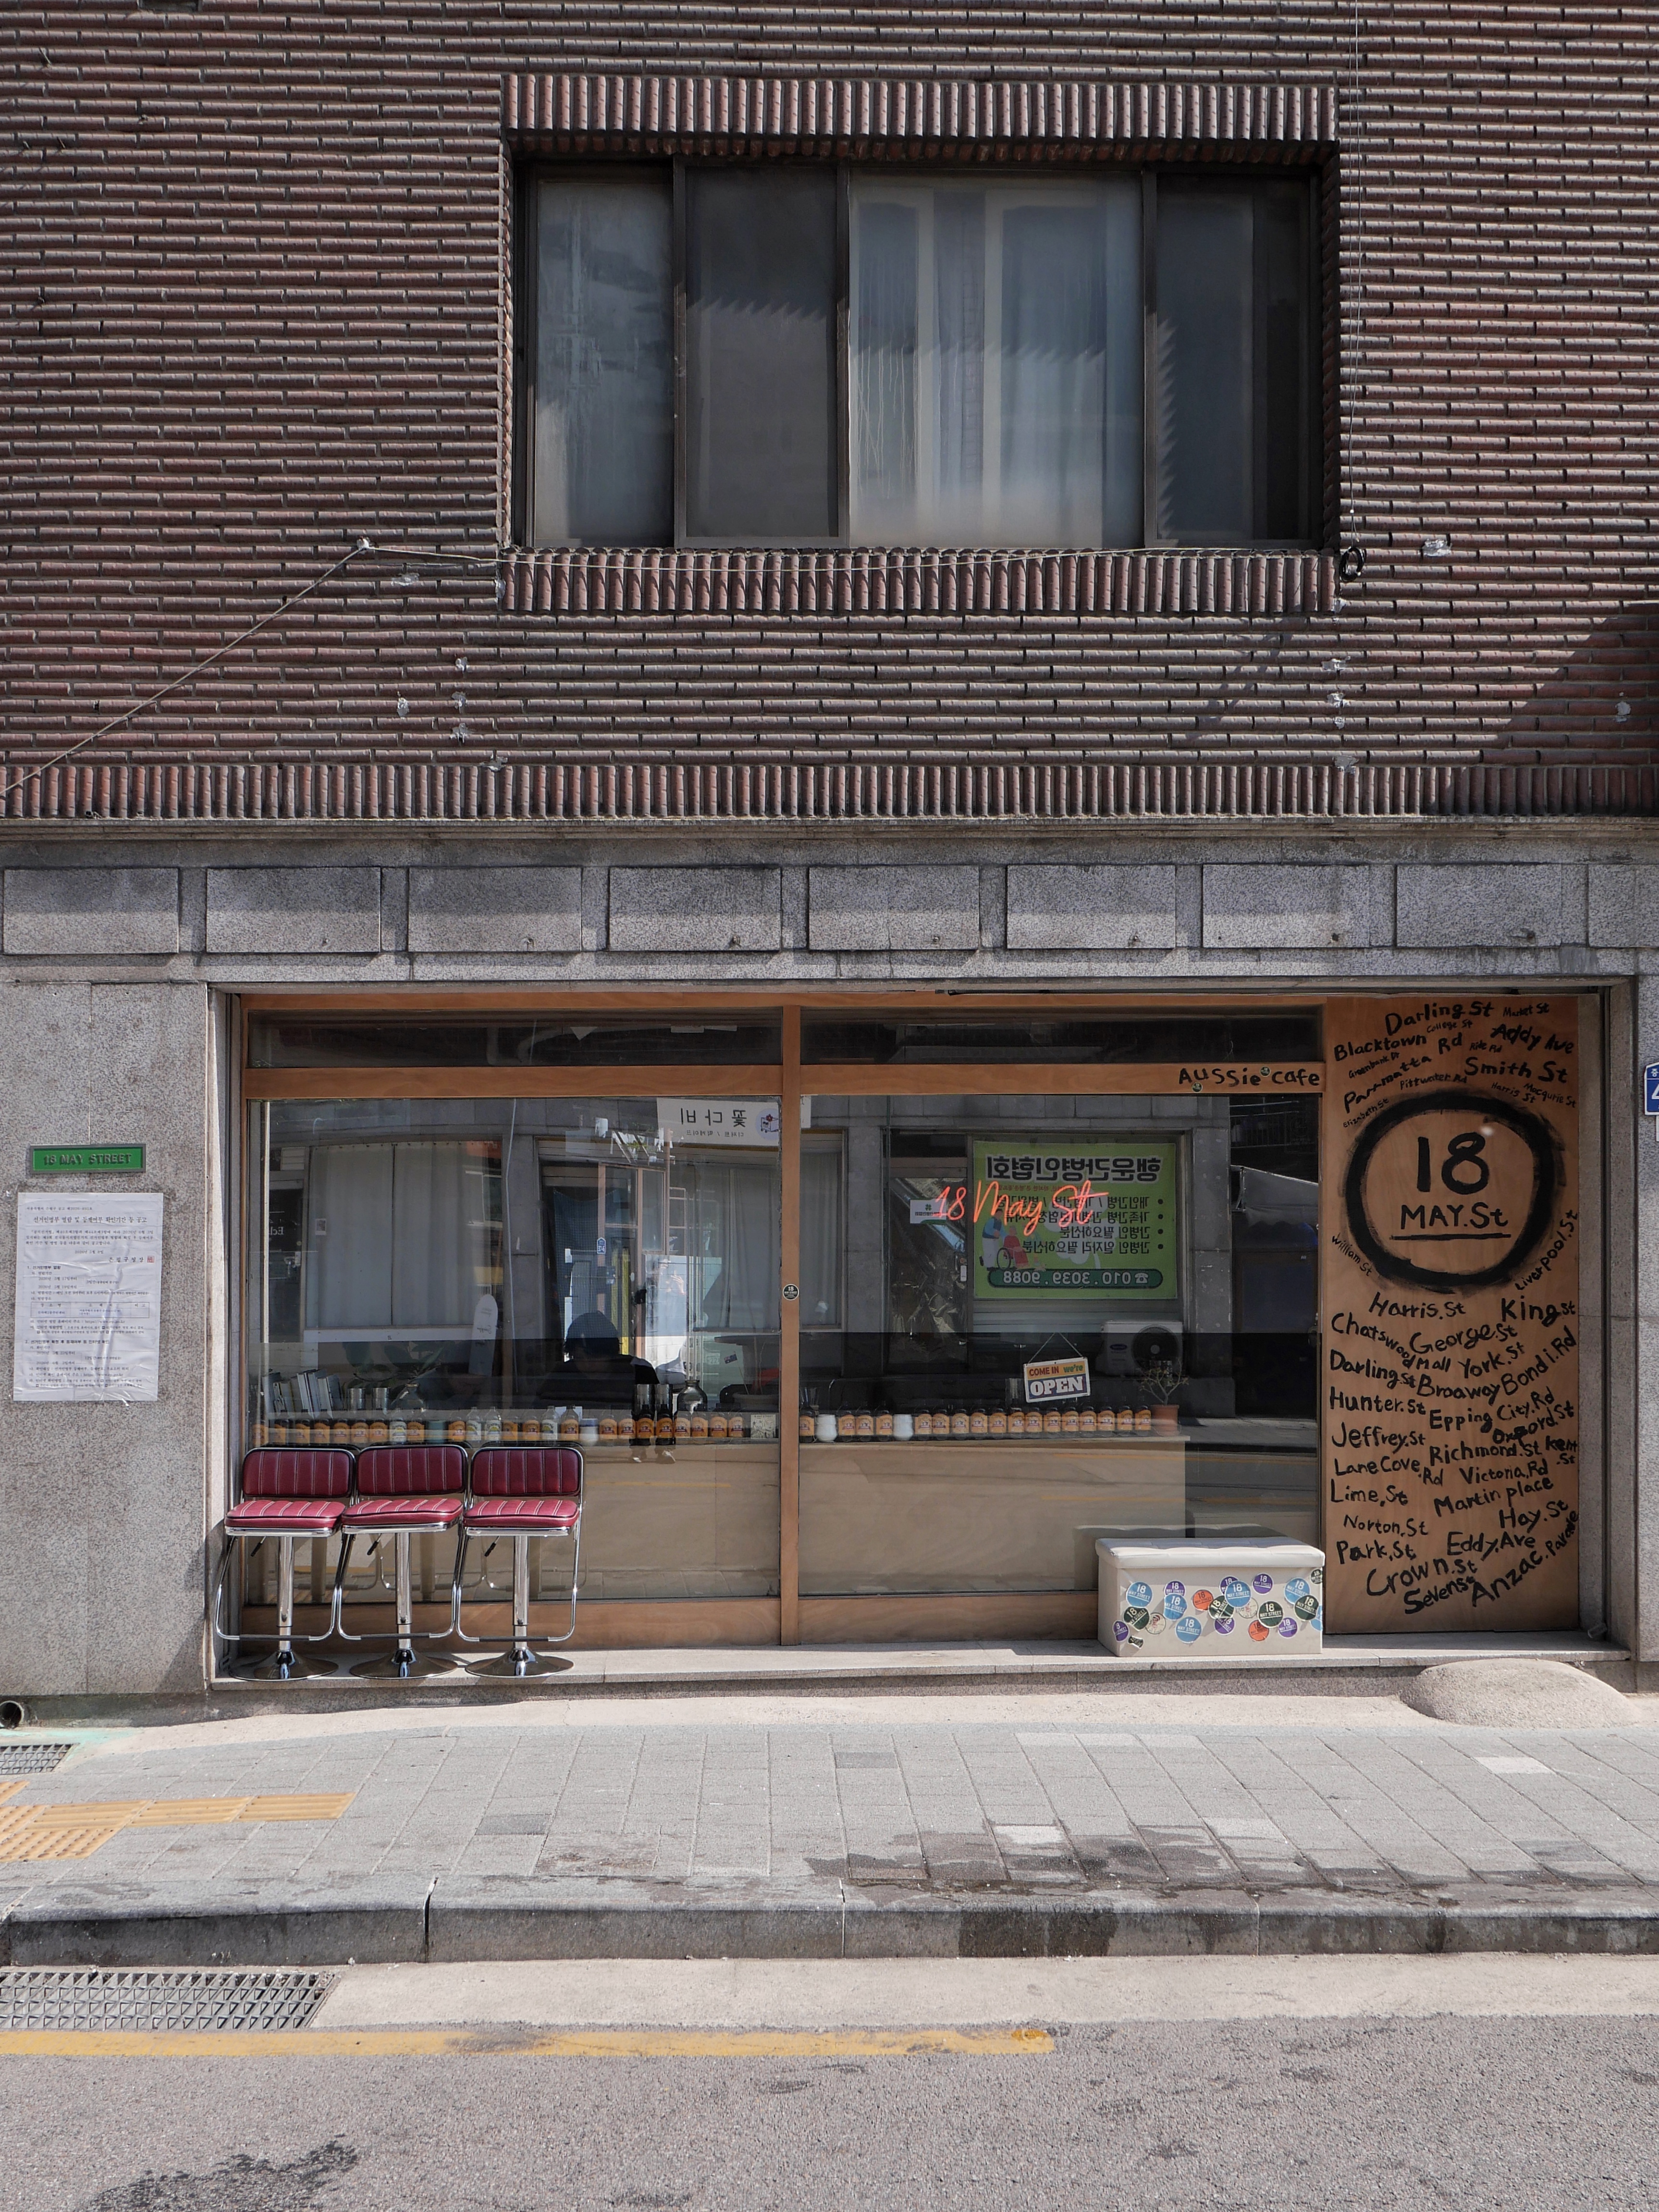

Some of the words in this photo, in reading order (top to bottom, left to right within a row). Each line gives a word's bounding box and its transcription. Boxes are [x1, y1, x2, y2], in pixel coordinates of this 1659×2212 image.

[1536, 1002, 1549, 1014] St
[1385, 1002, 1465, 1036] Darling
[1469, 1001, 1495, 1017] St
[1427, 1021, 1458, 1033] College
[1462, 1019, 1473, 1028] St
[1334, 1034, 1427, 1062] Blacktown
[1438, 1032, 1462, 1055] Rd
[1490, 1024, 1542, 1051] Addy
[1271, 1068, 1320, 1086] cafe
[1348, 1056, 1389, 1079] Greenbank
[1464, 1056, 1532, 1078] Smith
[1538, 1061, 1568, 1083] St
[1400, 1073, 1451, 1090] Pittwater
[1491, 1082, 1521, 1097] Harris
[1522, 1093, 1536, 1104] St
[1566, 1096, 1577, 1108] St
[1343, 1105, 1378, 1128] Elizabeth
[1378, 1098, 1389, 1109] St
[44, 1154, 57, 1165] 18
[60, 1154, 84, 1165] MAY
[89, 1153, 132, 1164] STREET
[1417, 1132, 1490, 1195] 18
[933, 1186, 967, 1221] 18
[973, 1180, 1043, 1236] May
[1053, 1179, 1109, 1228] St
[1332, 1232, 1361, 1264] William
[1360, 1262, 1372, 1276] St
[1501, 1295, 1561, 1327] King
[1331, 1312, 1417, 1368] Chatswood
[1029, 1367, 1050, 1376] COME
[1030, 1376, 1083, 1396] OPEN
[1429, 1408, 1493, 1433] Epping
[1334, 1458, 1379, 1476] Lane
[1380, 1456, 1421, 1473] Cove
[1434, 1489, 1501, 1517] Martin
[1137, 1584, 1146, 1594] 18
[1233, 1583, 1242, 1592] 18
[1295, 1580, 1304, 1590] 18
[1171, 1596, 1180, 1605] 18
[1211, 1600, 1221, 1609] 18
[1266, 1603, 1274, 1612] 18
[1304, 1596, 1314, 1606] 18
[1127, 1608, 1137, 1618] 18
[1185, 1619, 1194, 1627] 18
